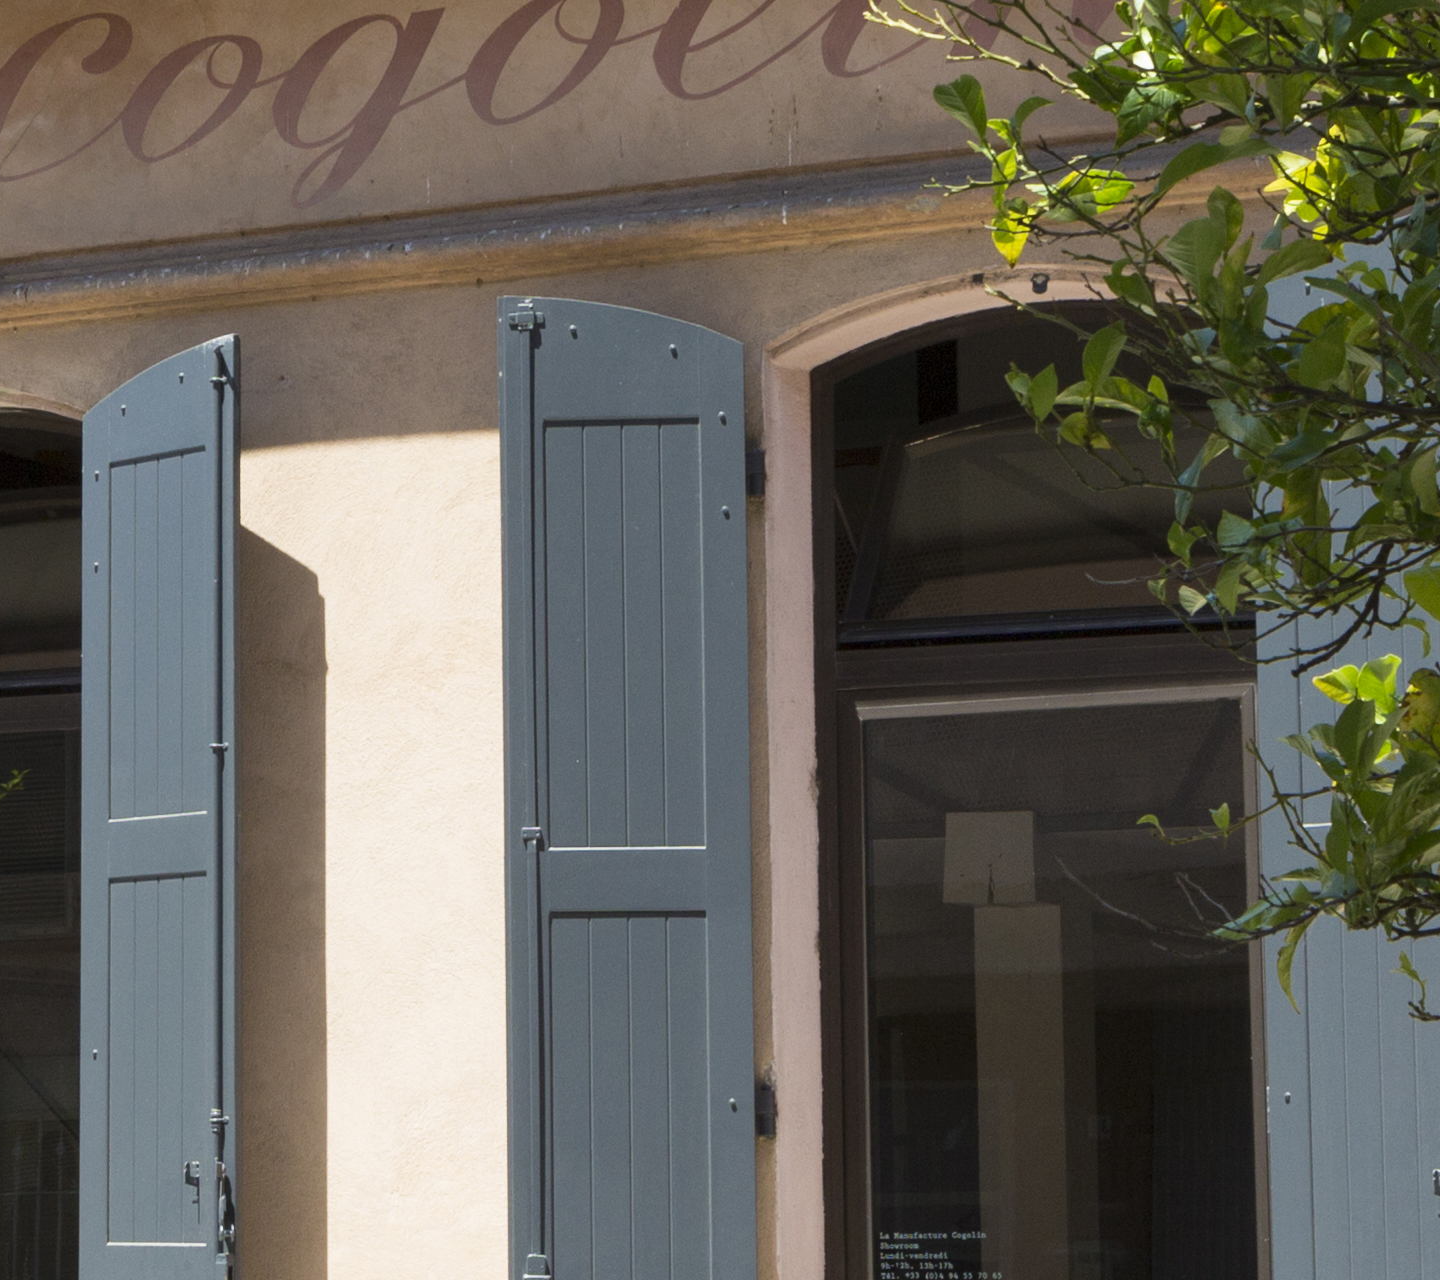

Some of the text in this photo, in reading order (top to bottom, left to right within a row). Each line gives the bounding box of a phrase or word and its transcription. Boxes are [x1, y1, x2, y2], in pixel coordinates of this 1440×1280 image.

[879, 1231, 987, 1240] La Manufacture Cogolin
[879, 1242, 919, 1250] Showroom
[879, 1252, 949, 1260] Lundi-vendredi
